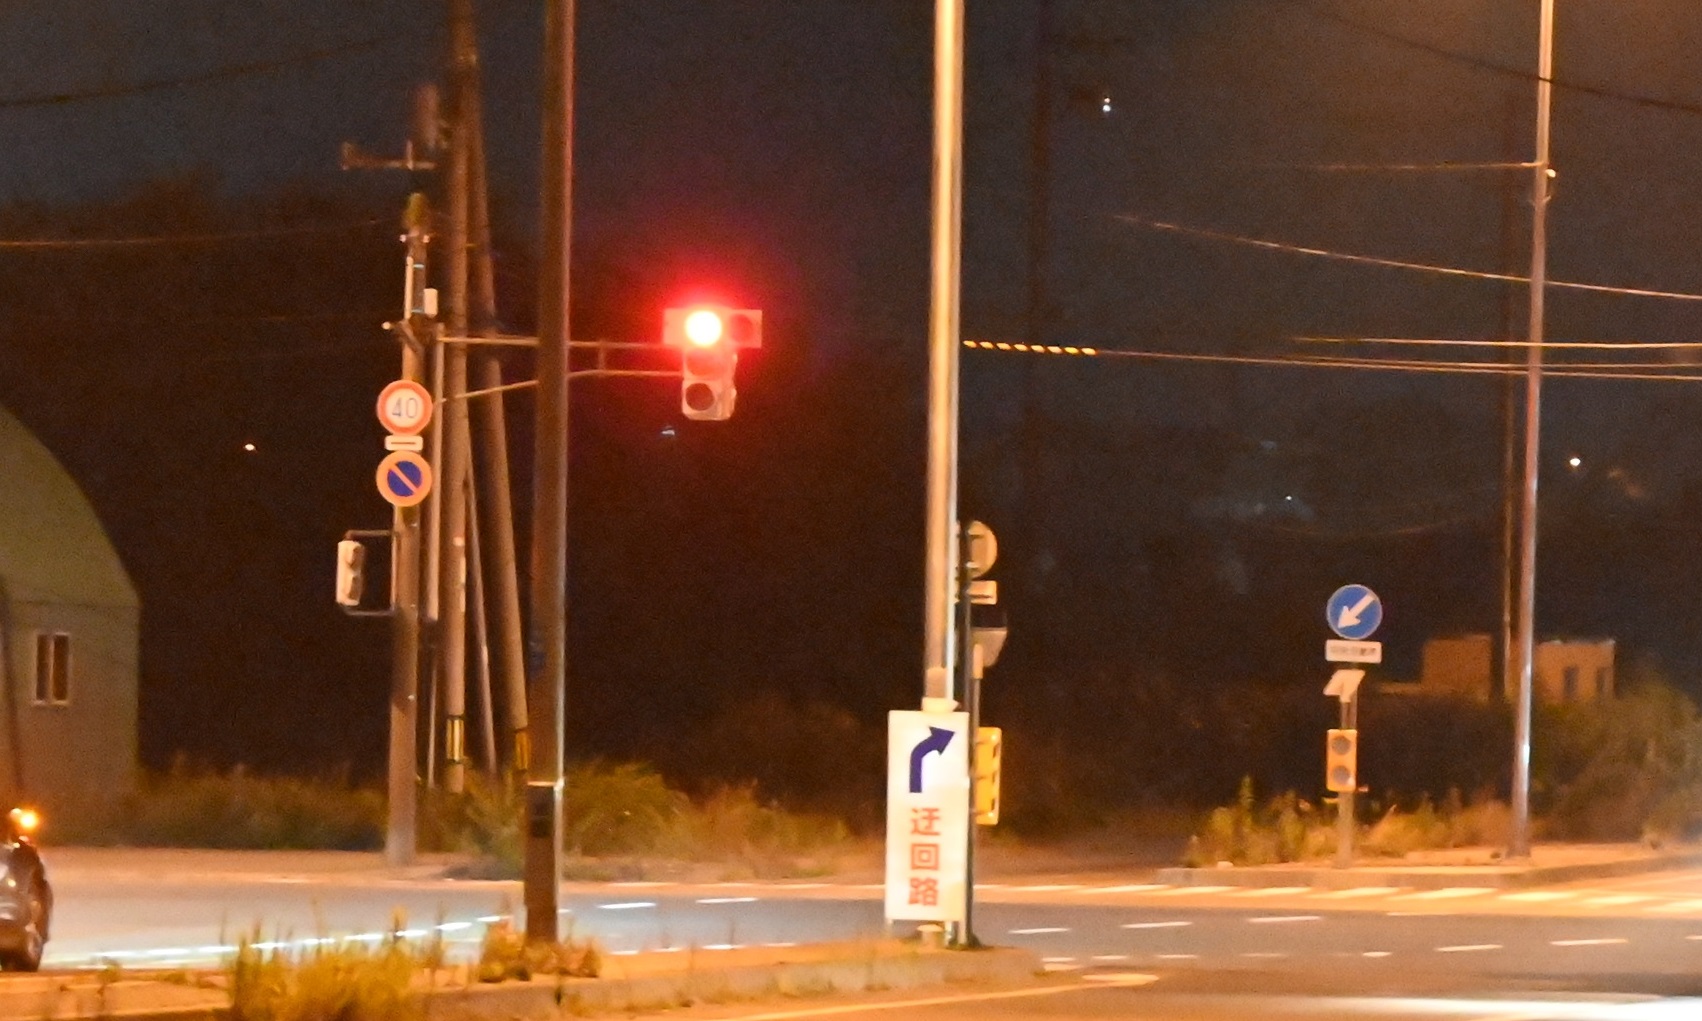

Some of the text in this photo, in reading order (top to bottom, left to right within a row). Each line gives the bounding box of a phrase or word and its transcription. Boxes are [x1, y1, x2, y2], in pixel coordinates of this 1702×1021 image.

[392, 397, 418, 419] 40
[908, 807, 941, 907] 迂回路
